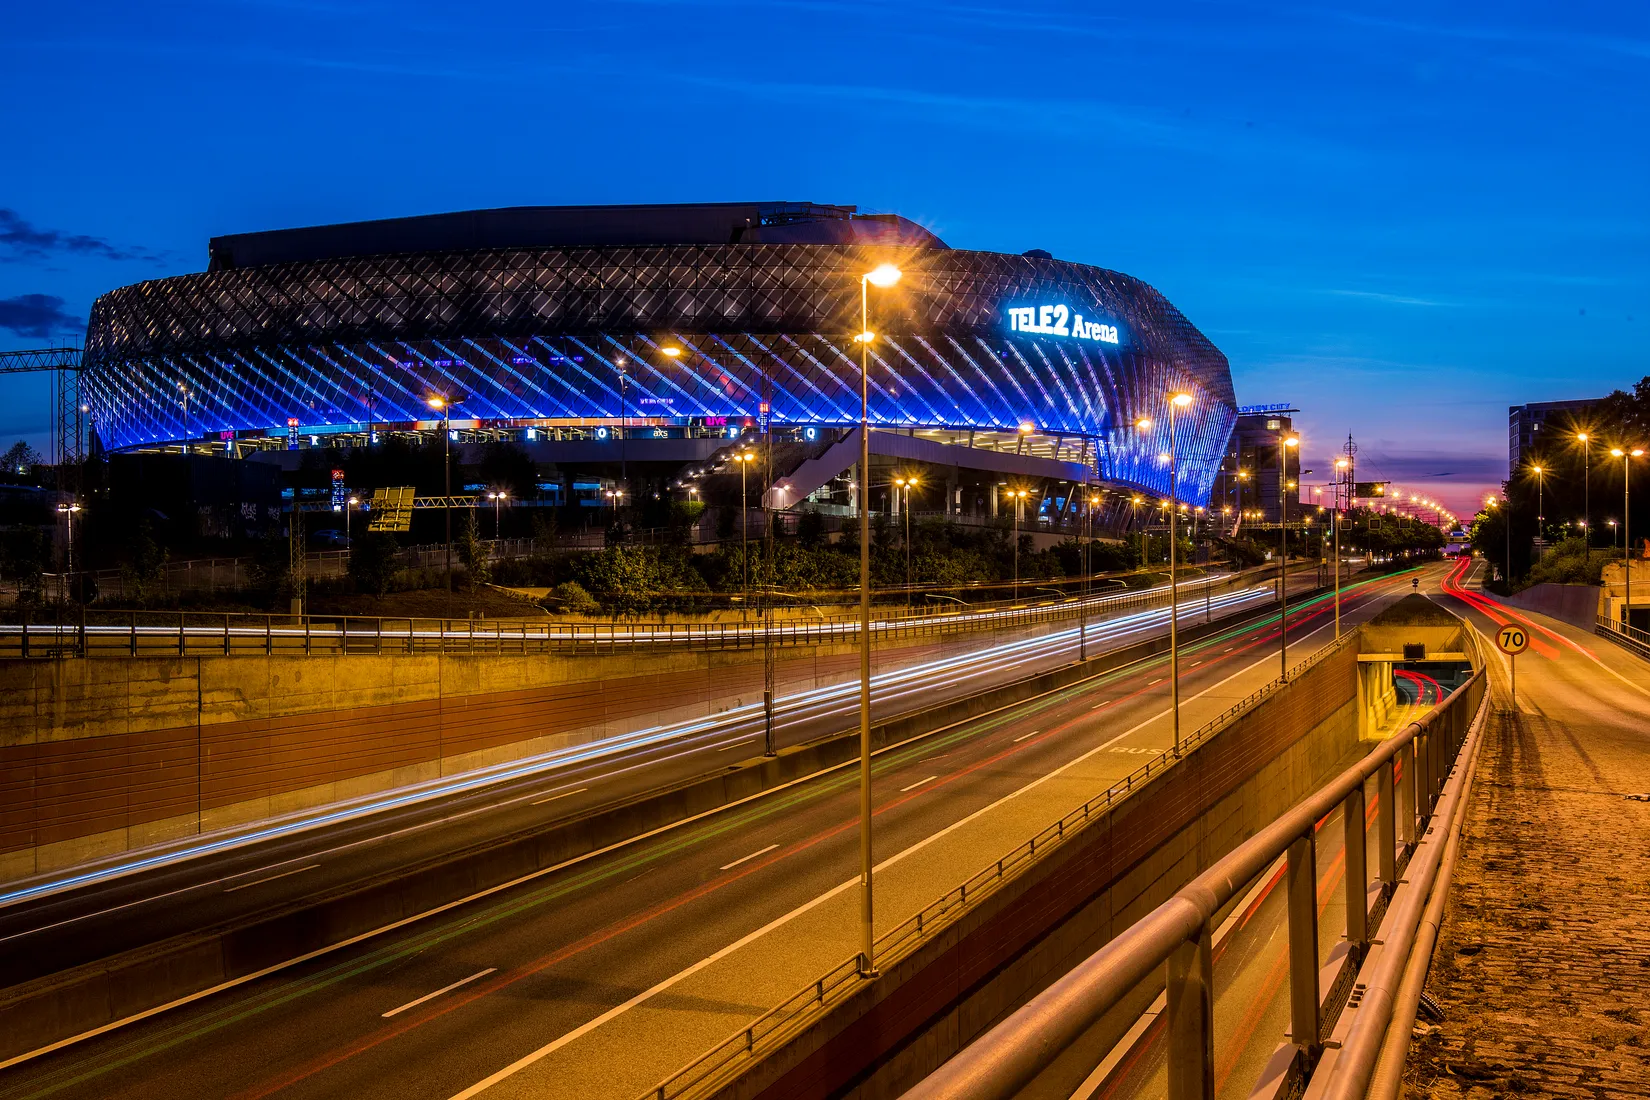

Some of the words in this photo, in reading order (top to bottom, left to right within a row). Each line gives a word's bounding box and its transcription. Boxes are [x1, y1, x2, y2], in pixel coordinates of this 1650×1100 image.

[1008, 304, 1069, 336] TELE2
[1071, 314, 1119, 344] Arena
[705, 416, 727, 426] LIVE
[729, 428, 737, 438] P
[806, 428, 815, 439] Q
[1502, 632, 1524, 647] 70
